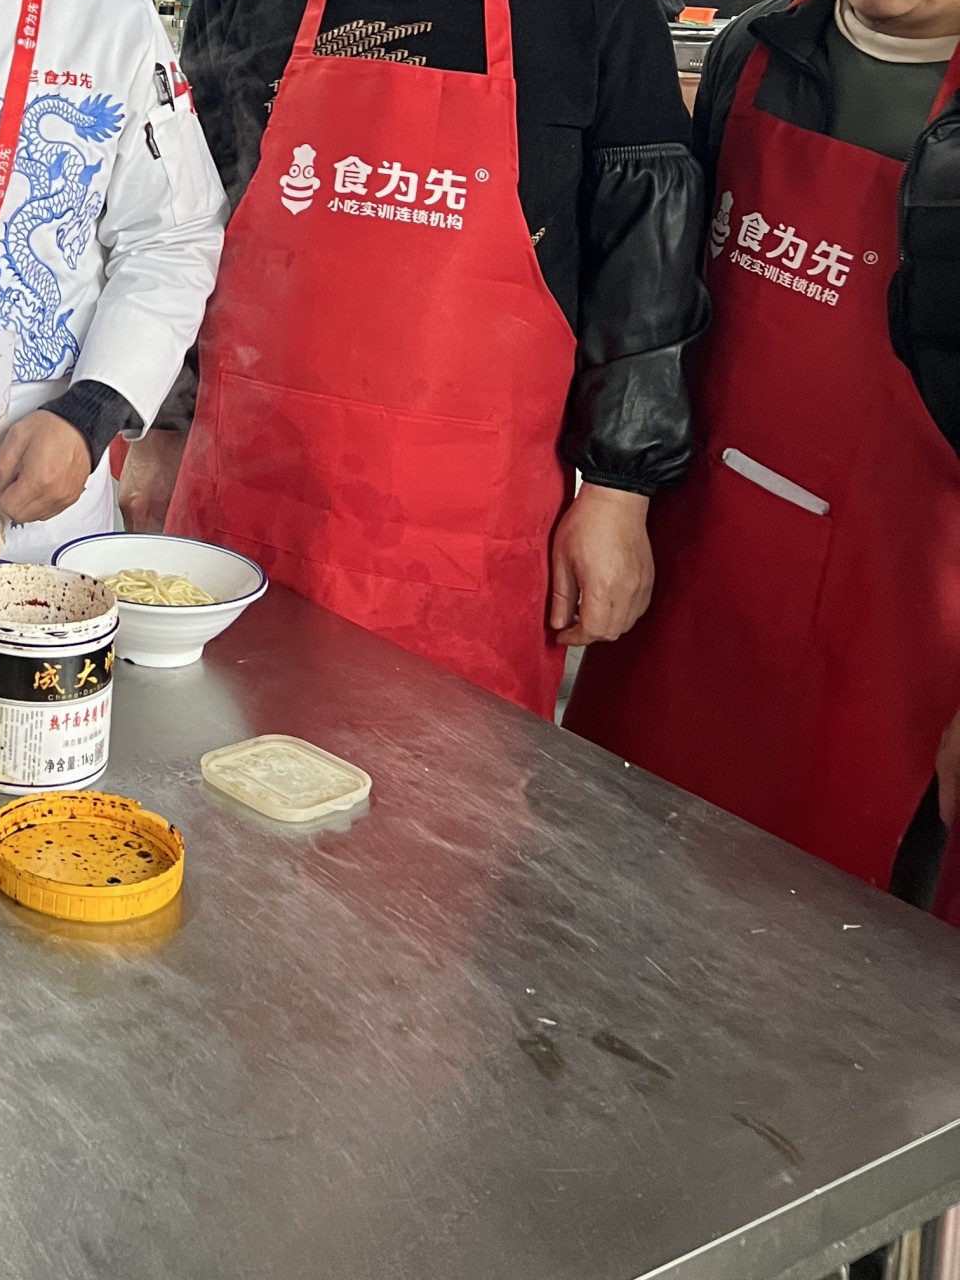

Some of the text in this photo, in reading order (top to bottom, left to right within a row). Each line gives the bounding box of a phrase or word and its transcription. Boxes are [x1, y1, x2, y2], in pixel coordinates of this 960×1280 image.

[23, 2, 39, 37] 食为先
[44, 70, 93, 89] 食为先
[333, 155, 467, 210] 食为先
[327, 197, 463, 230] 小吃实训连锁机构
[737, 211, 854, 287] 食为先
[729, 249, 840, 307] 小吃实训连锁机构
